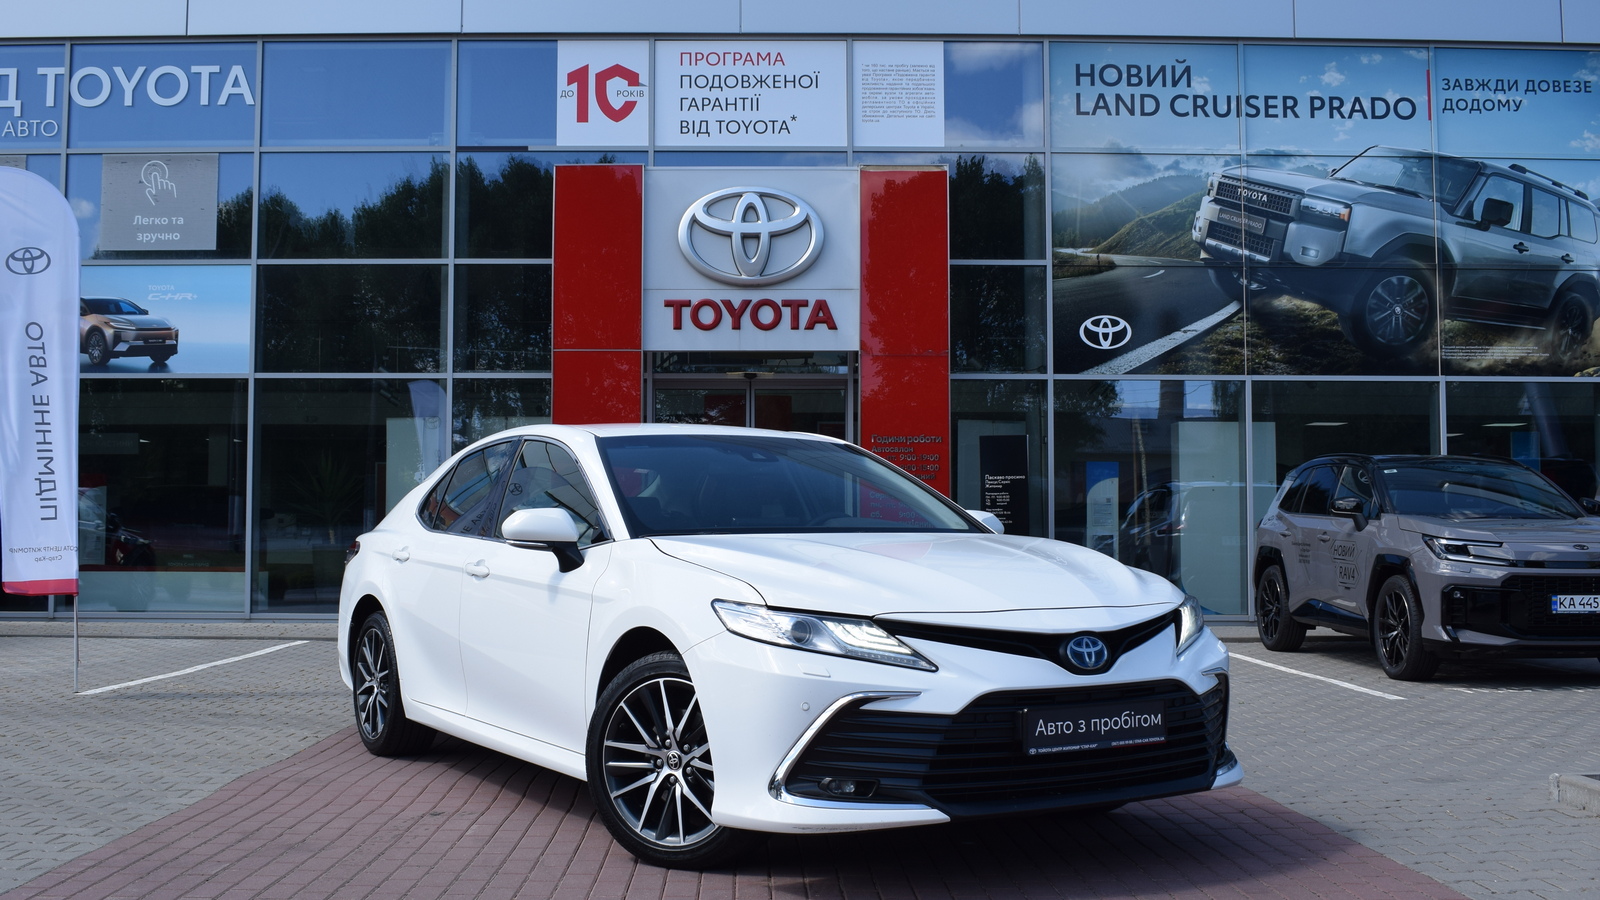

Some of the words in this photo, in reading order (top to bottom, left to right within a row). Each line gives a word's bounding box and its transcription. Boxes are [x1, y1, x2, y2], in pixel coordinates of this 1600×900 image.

[679, 51, 786, 67] ПРОГРАМА
[679, 70, 821, 91] ПОДОВЖЕНОЇ
[1075, 58, 1192, 88] НОВИЙ
[37, 65, 255, 108] TOYOTA
[560, 89, 575, 99] ДО
[616, 89, 645, 98] РОКІВ
[1442, 77, 1519, 95] ЗАВЖДИ
[1524, 79, 1592, 95] ДОВЕЗЕ
[679, 93, 760, 112] ГАРАНТІЇ
[1075, 92, 1161, 117] LAND
[1169, 93, 1300, 118] CRUISER
[1309, 95, 1417, 120] PRADO
[1442, 98, 1523, 114] ДОДОМУ
[1, 119, 59, 137] АВТО
[679, 119, 711, 137] ВІД
[1238, 188, 1268, 202] TOYOTA
[133, 215, 169, 226] Легко
[171, 216, 184, 225] та
[136, 232, 181, 243] зручно
[663, 298, 838, 331] TOYOTA
[871, 434, 906, 444] Години
[907, 434, 942, 445] роботи
[871, 445, 914, 453] Автосалон
[1333, 543, 1356, 558] НОВИЙ
[1338, 566, 1356, 581] RAV4
[1558, 597, 1576, 609] KA
[1578, 597, 1600, 609] 445
[1035, 718, 1074, 736] Авто
[1078, 720, 1086, 733] з
[1091, 711, 1162, 735] пробігом
